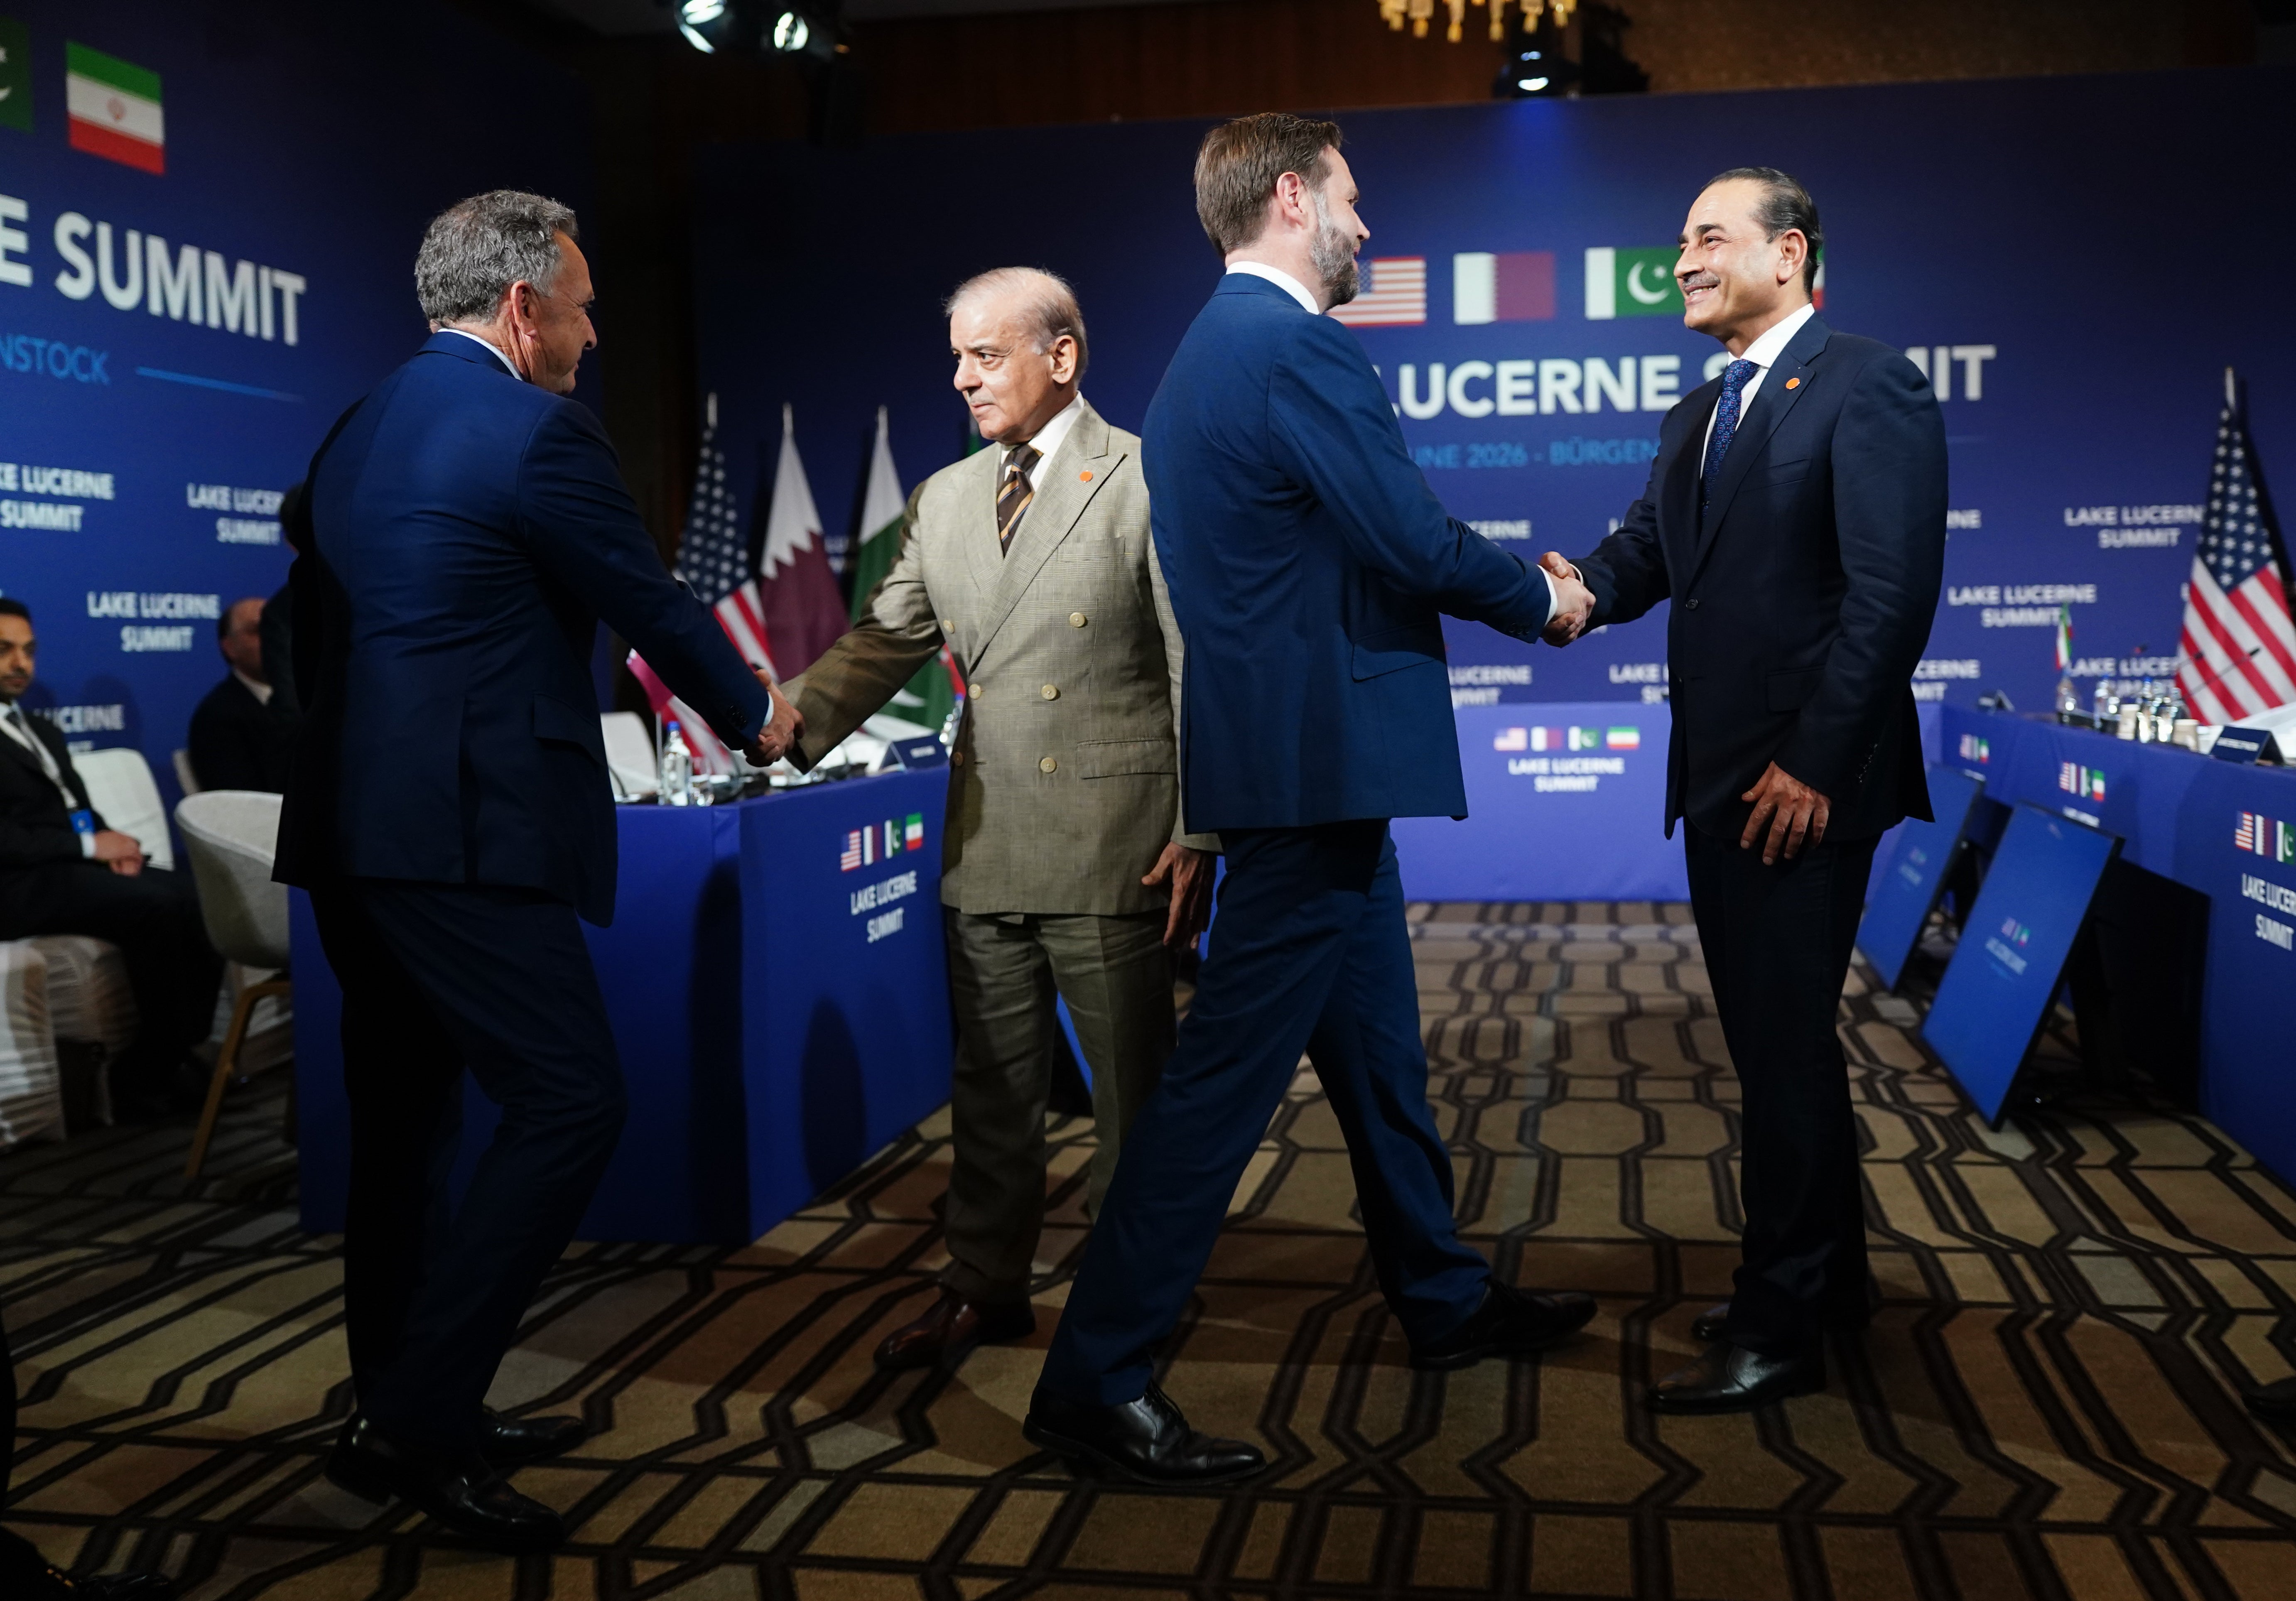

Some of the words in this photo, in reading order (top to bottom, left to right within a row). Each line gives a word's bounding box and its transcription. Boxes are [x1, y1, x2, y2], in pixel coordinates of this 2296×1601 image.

[54, 211, 307, 346] SUMMIT
[1373, 355, 1681, 419] UCERNE
[22, 464, 115, 500] LUCERNE
[187, 482, 231, 511] LAKE
[0, 499, 83, 532] SUMMIT
[2064, 506, 2118, 526] LAKE
[2120, 504, 2206, 525] LUCERN
[216, 517, 282, 545] SUMMIT
[2098, 527, 2181, 548] SUMMIT
[87, 591, 137, 618] LAKE
[140, 593, 221, 620] LUCERNE
[1948, 586, 2001, 606] LAKE
[2003, 584, 2097, 605] LUCERNE
[1981, 607, 2063, 628] SUMMIT
[121, 625, 194, 652] SUMMIT
[1609, 664, 1661, 684] LAKE
[1508, 758, 1550, 775] LAKE
[1551, 757, 1625, 775] LUCERNE
[1534, 775, 1599, 792] SUMMIT
[851, 885, 876, 915] LAKE
[876, 870, 917, 905] LUCERNE
[2242, 873, 2266, 904] LAKE
[867, 907, 904, 943] SUMMIT
[2255, 913, 2294, 951] SUMMIT
